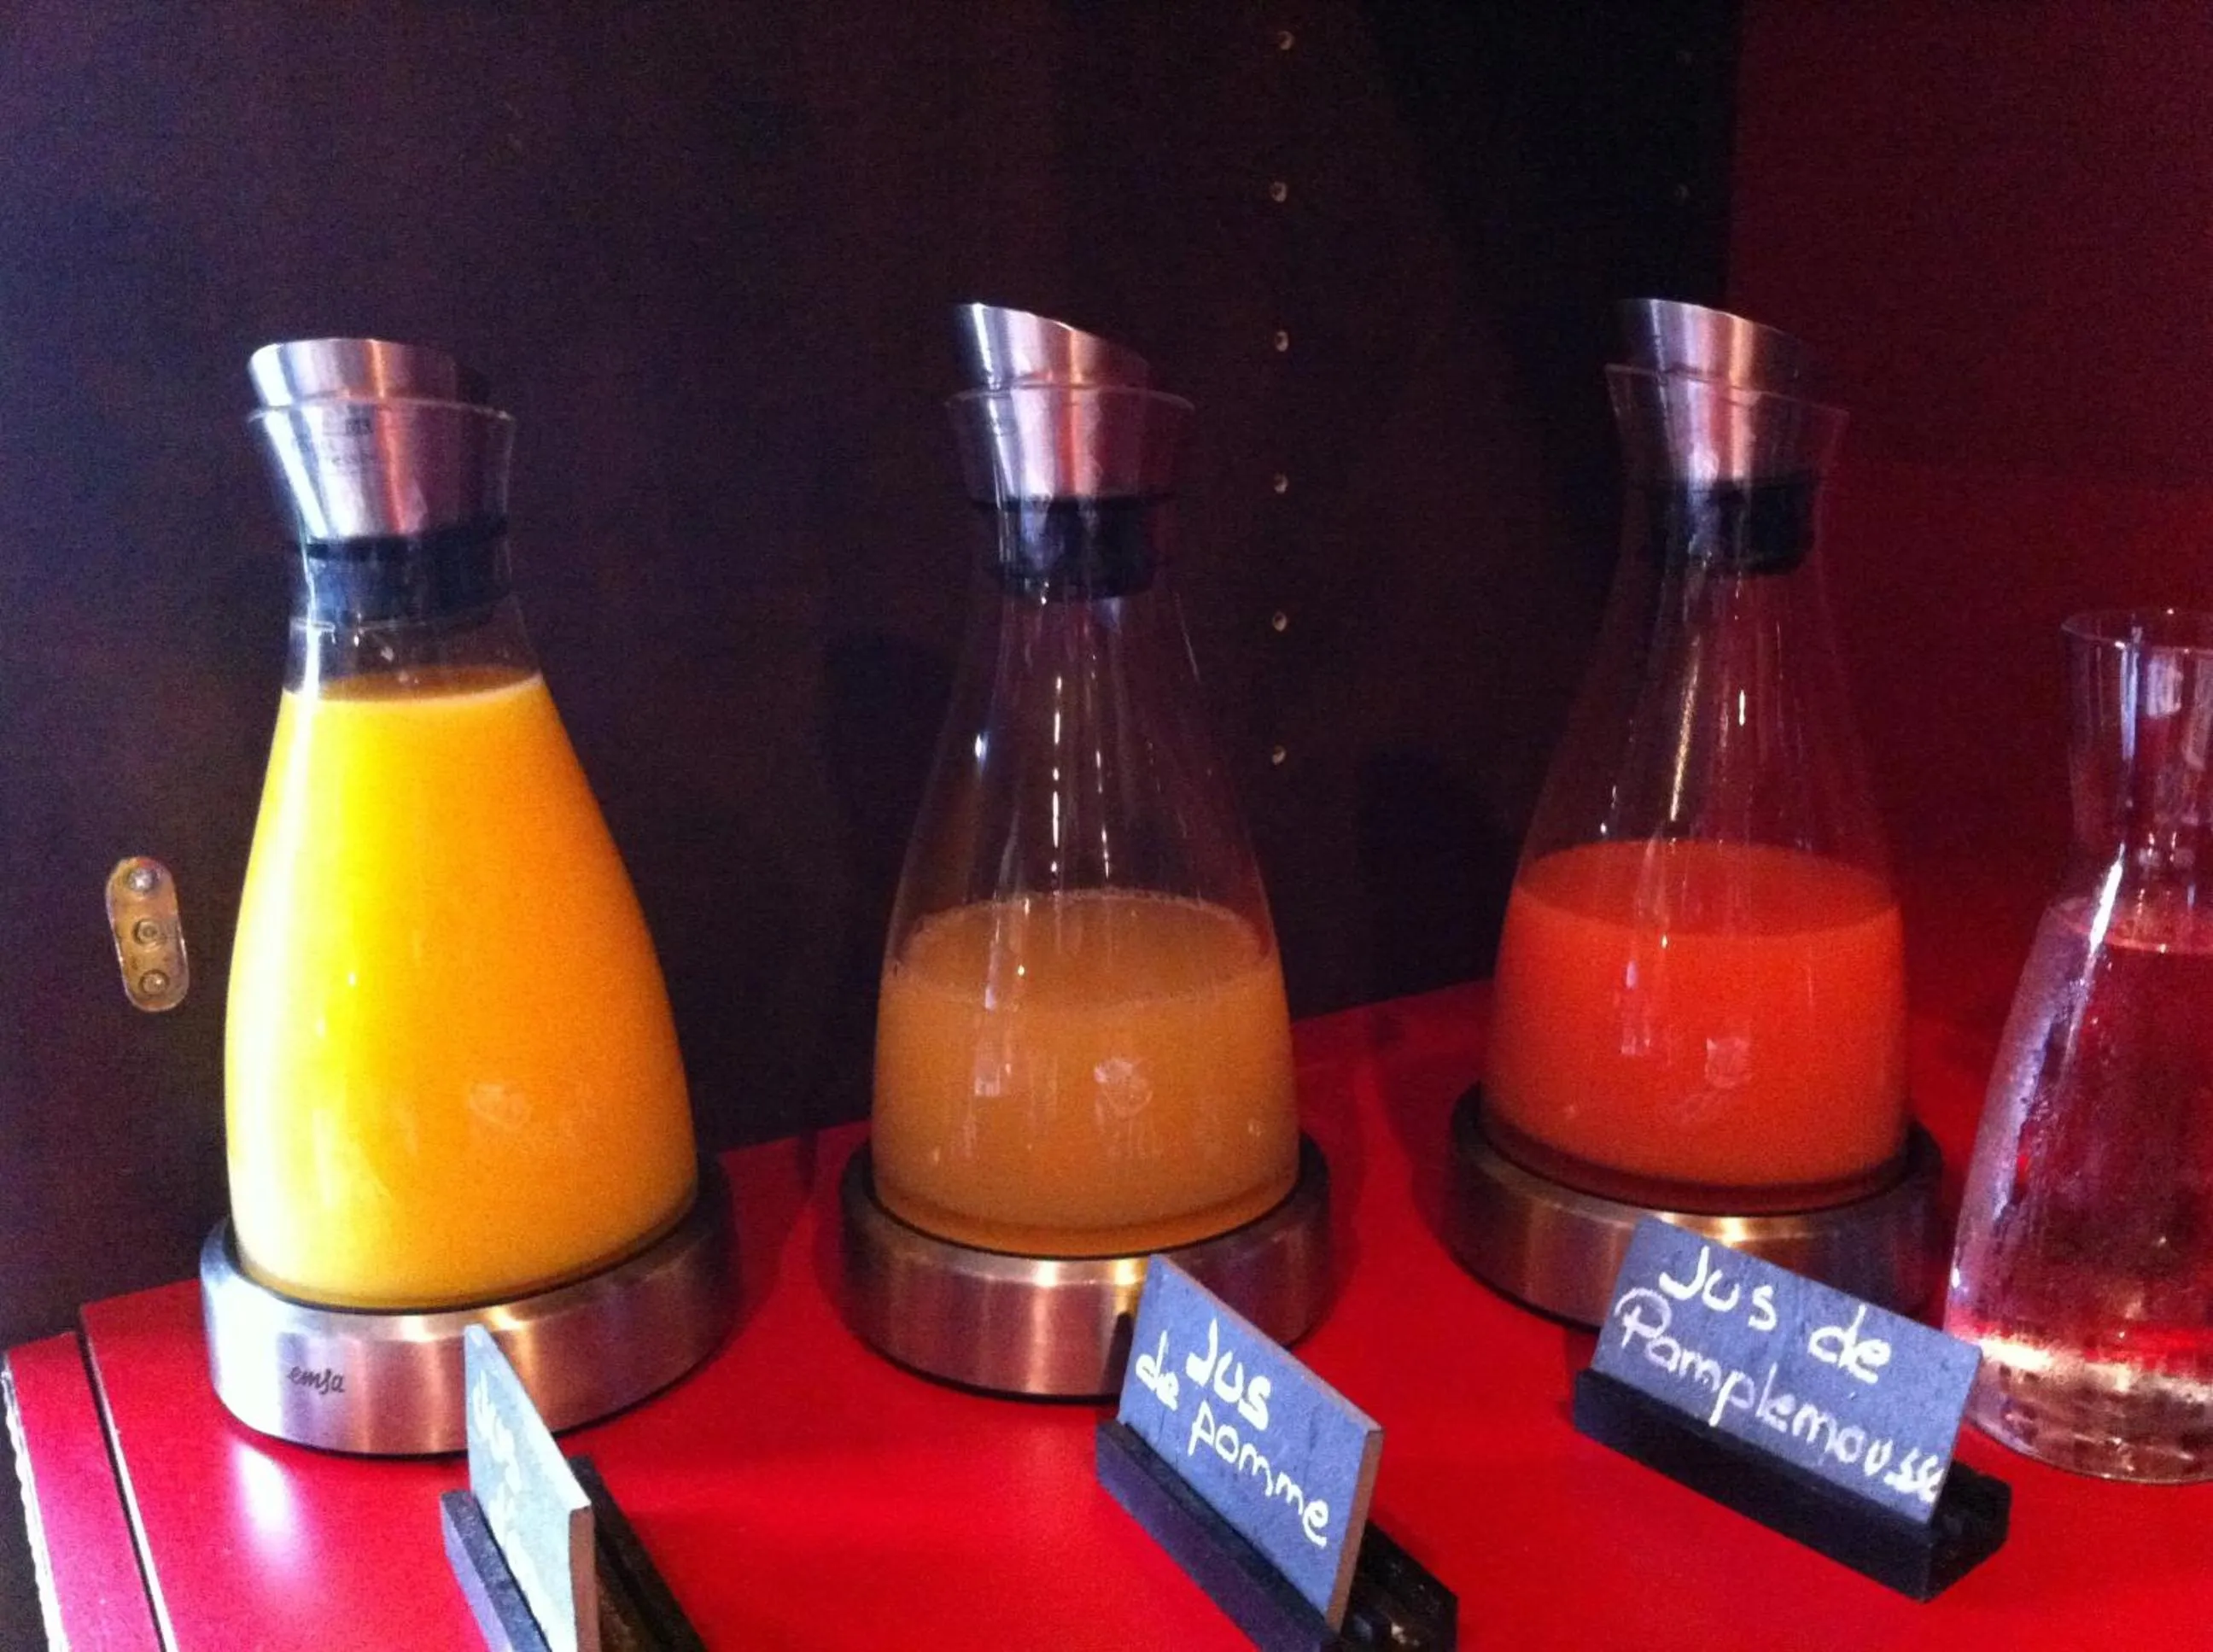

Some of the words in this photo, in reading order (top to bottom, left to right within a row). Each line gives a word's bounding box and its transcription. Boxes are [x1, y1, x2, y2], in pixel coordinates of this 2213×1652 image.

[1659, 1246, 1778, 1331] Jus
[1807, 1304, 1892, 1383] de
[286, 1366, 346, 1395] emsa
[1136, 1329, 1180, 1411] de
[1186, 1318, 1272, 1431] Jus
